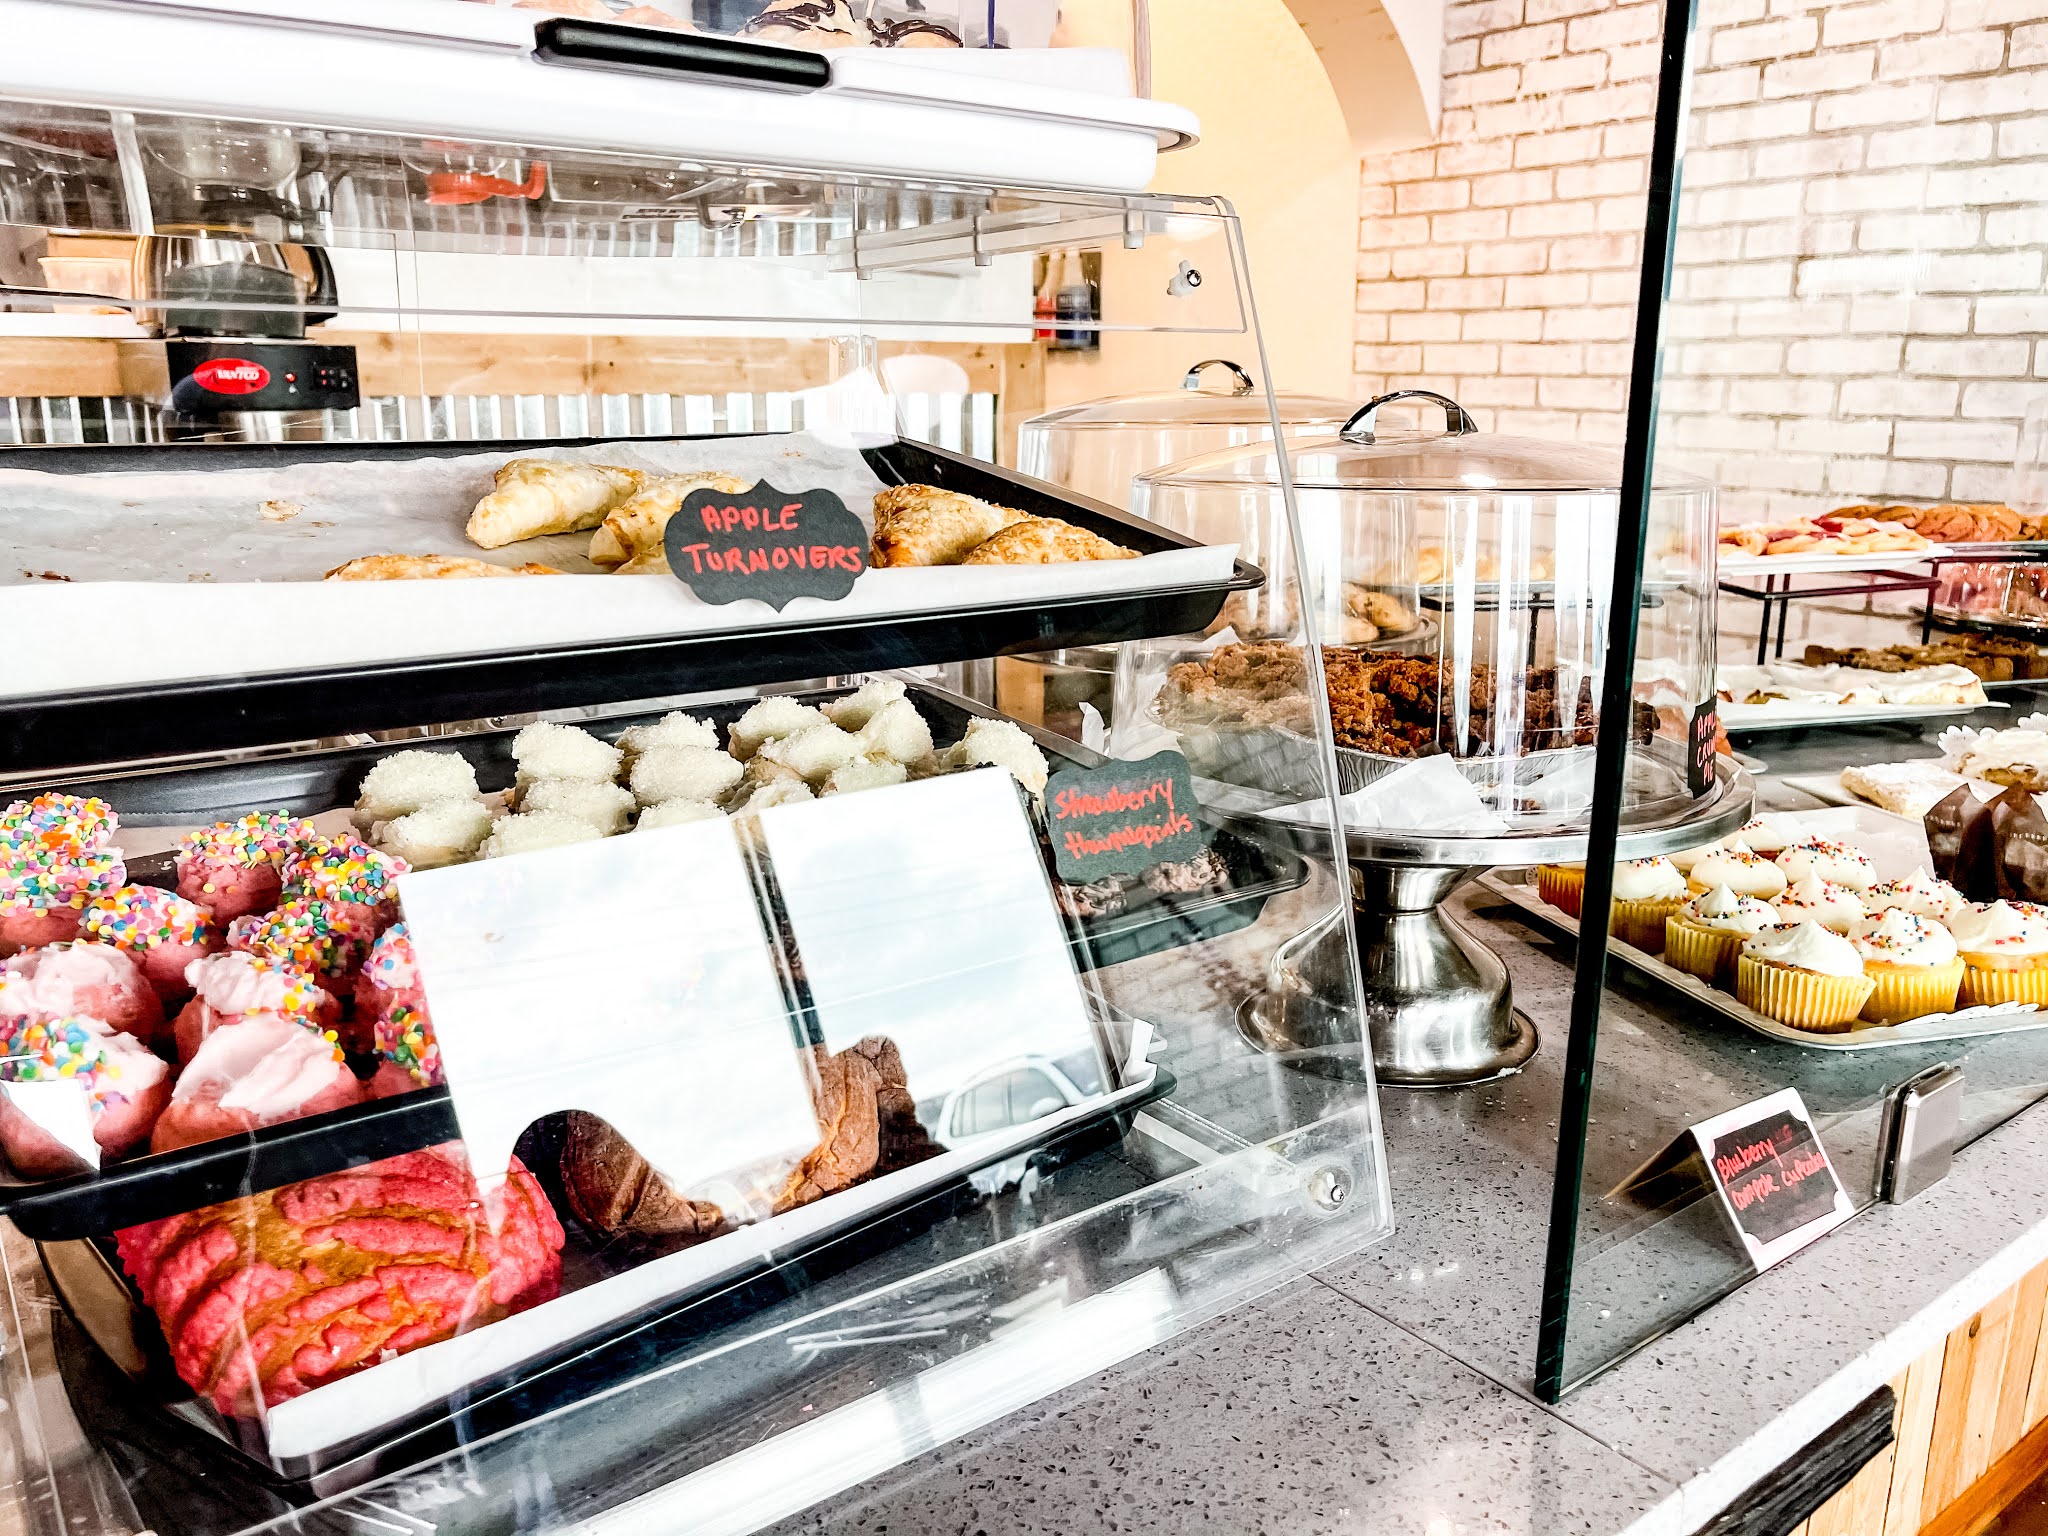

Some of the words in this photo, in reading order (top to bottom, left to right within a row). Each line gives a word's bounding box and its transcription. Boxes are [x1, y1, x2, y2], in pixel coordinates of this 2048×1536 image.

[701, 503, 803, 533] APPLE
[681, 543, 862, 575] TURNOVERS
[1703, 759, 1714, 786] PIE
[1716, 1138, 1784, 1188] Blueberry
